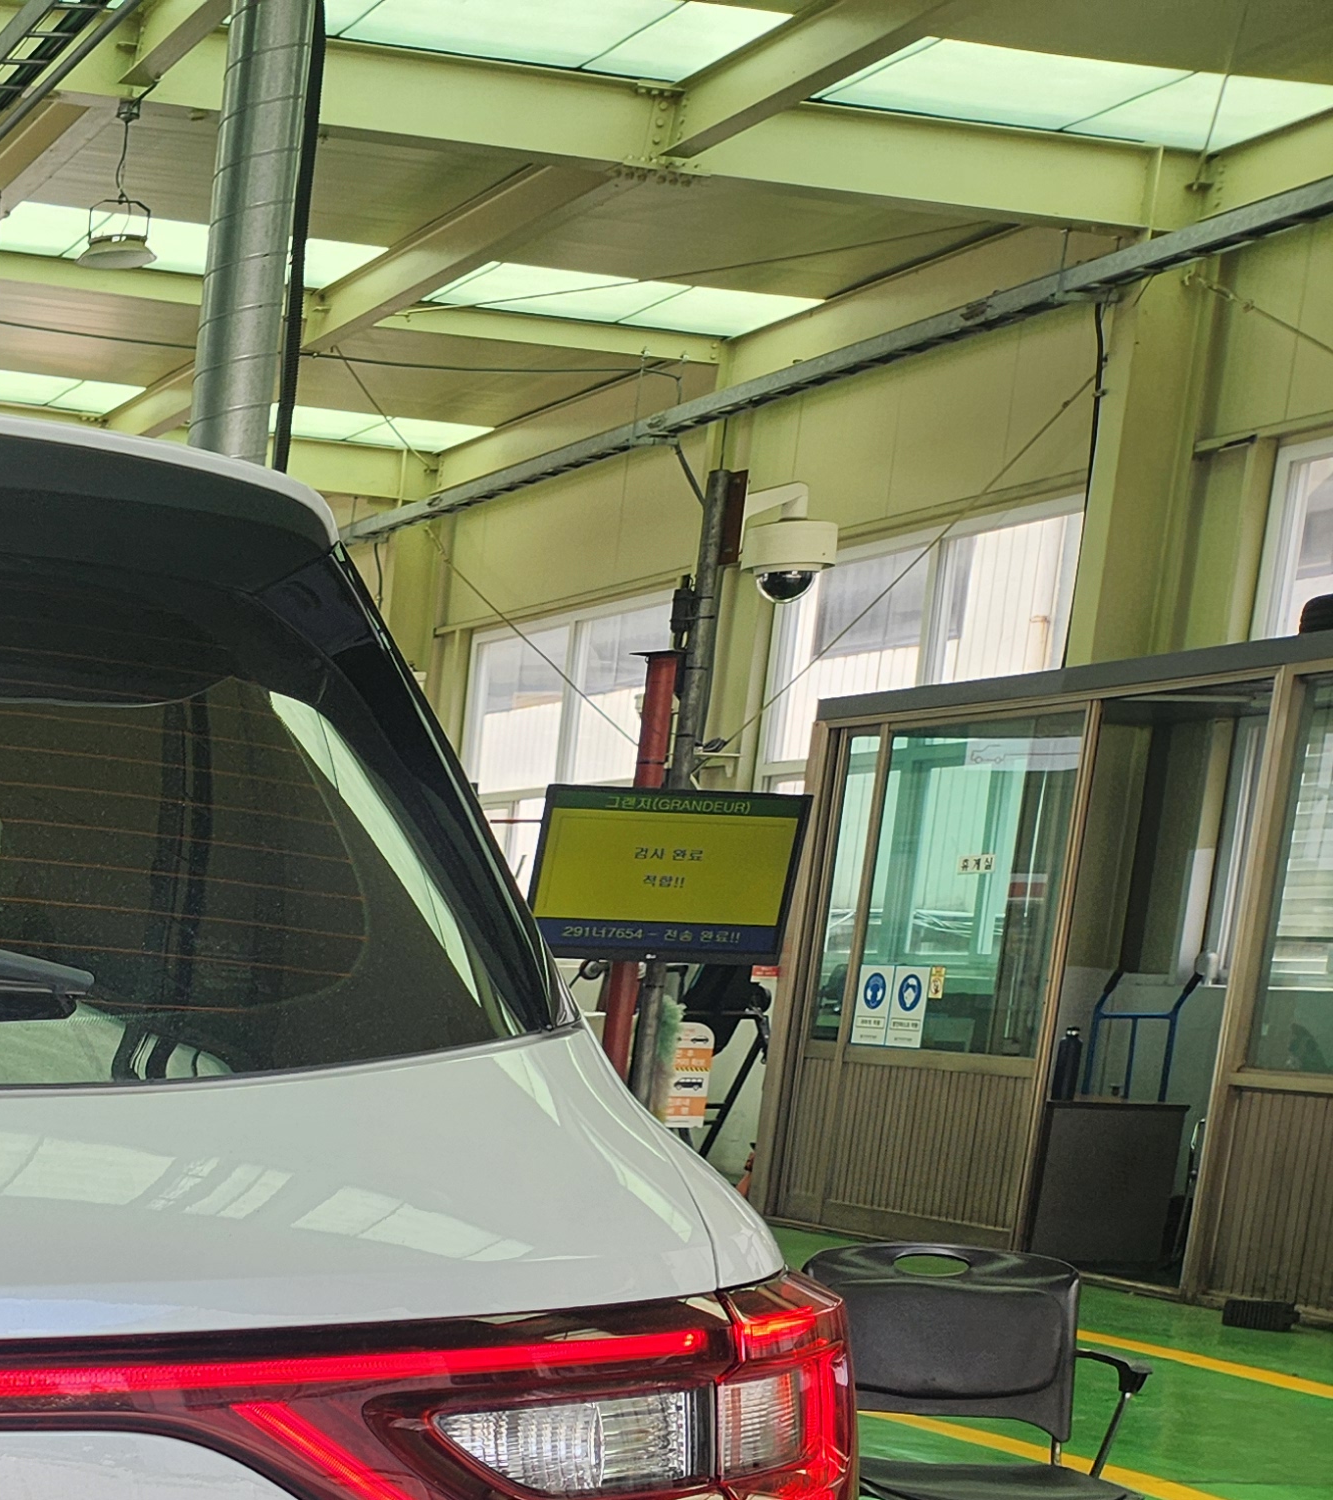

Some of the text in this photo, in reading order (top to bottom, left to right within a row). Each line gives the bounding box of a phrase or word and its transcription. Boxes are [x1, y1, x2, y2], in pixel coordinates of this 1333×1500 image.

[634, 846, 704, 862] 검사 완료
[561, 925, 644, 940] 291너7654
[663, 928, 693, 943] 전송
[699, 930, 741, 944] 완료!!
